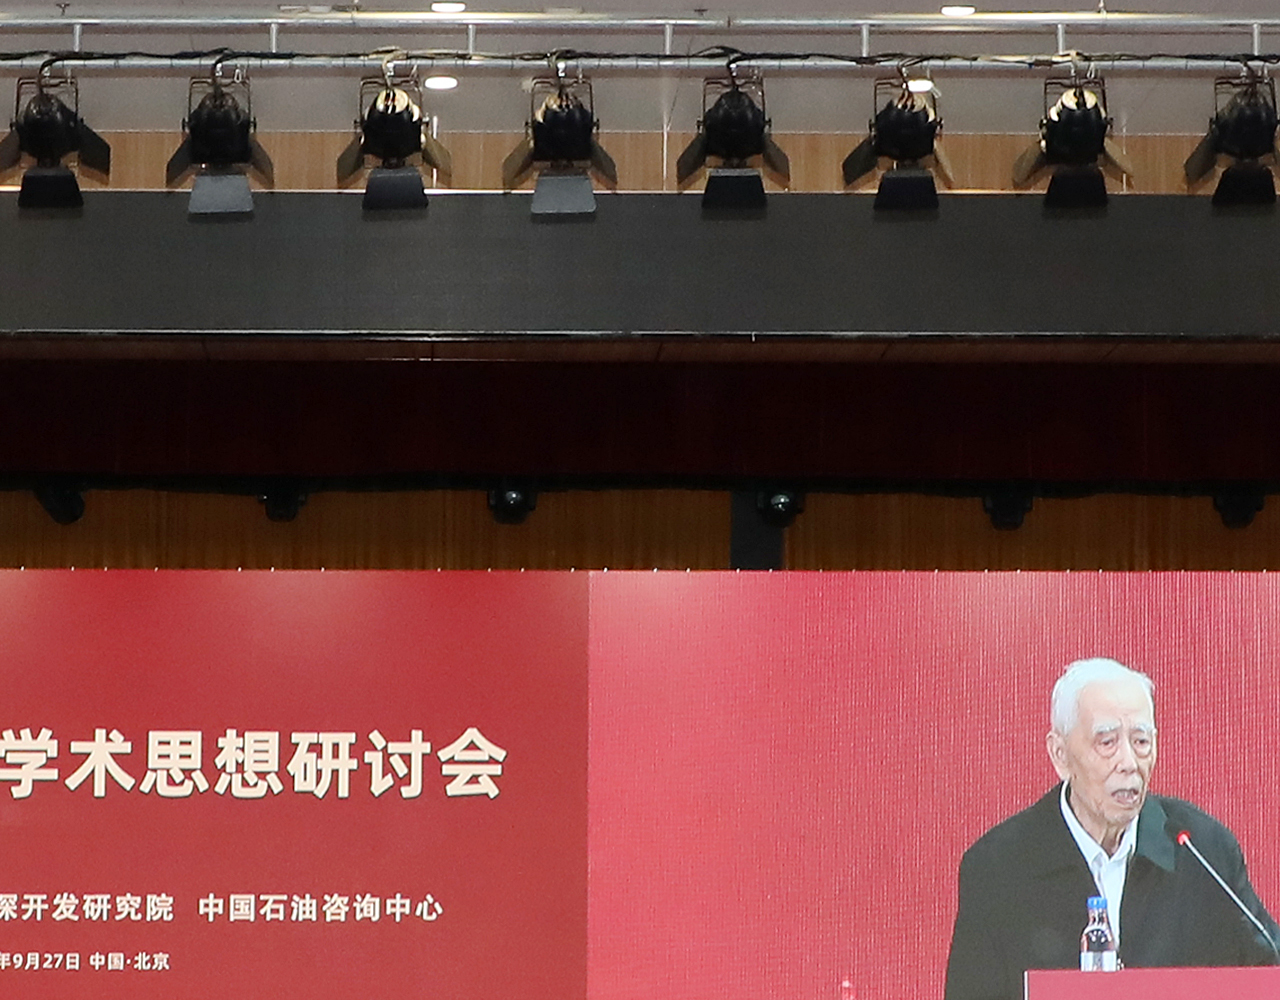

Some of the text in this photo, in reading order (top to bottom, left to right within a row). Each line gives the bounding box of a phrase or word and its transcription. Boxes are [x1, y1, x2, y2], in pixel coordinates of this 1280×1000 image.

[198, 893, 445, 923] 中国石油咨询中心
[89, 951, 170, 970] 中国·北京
